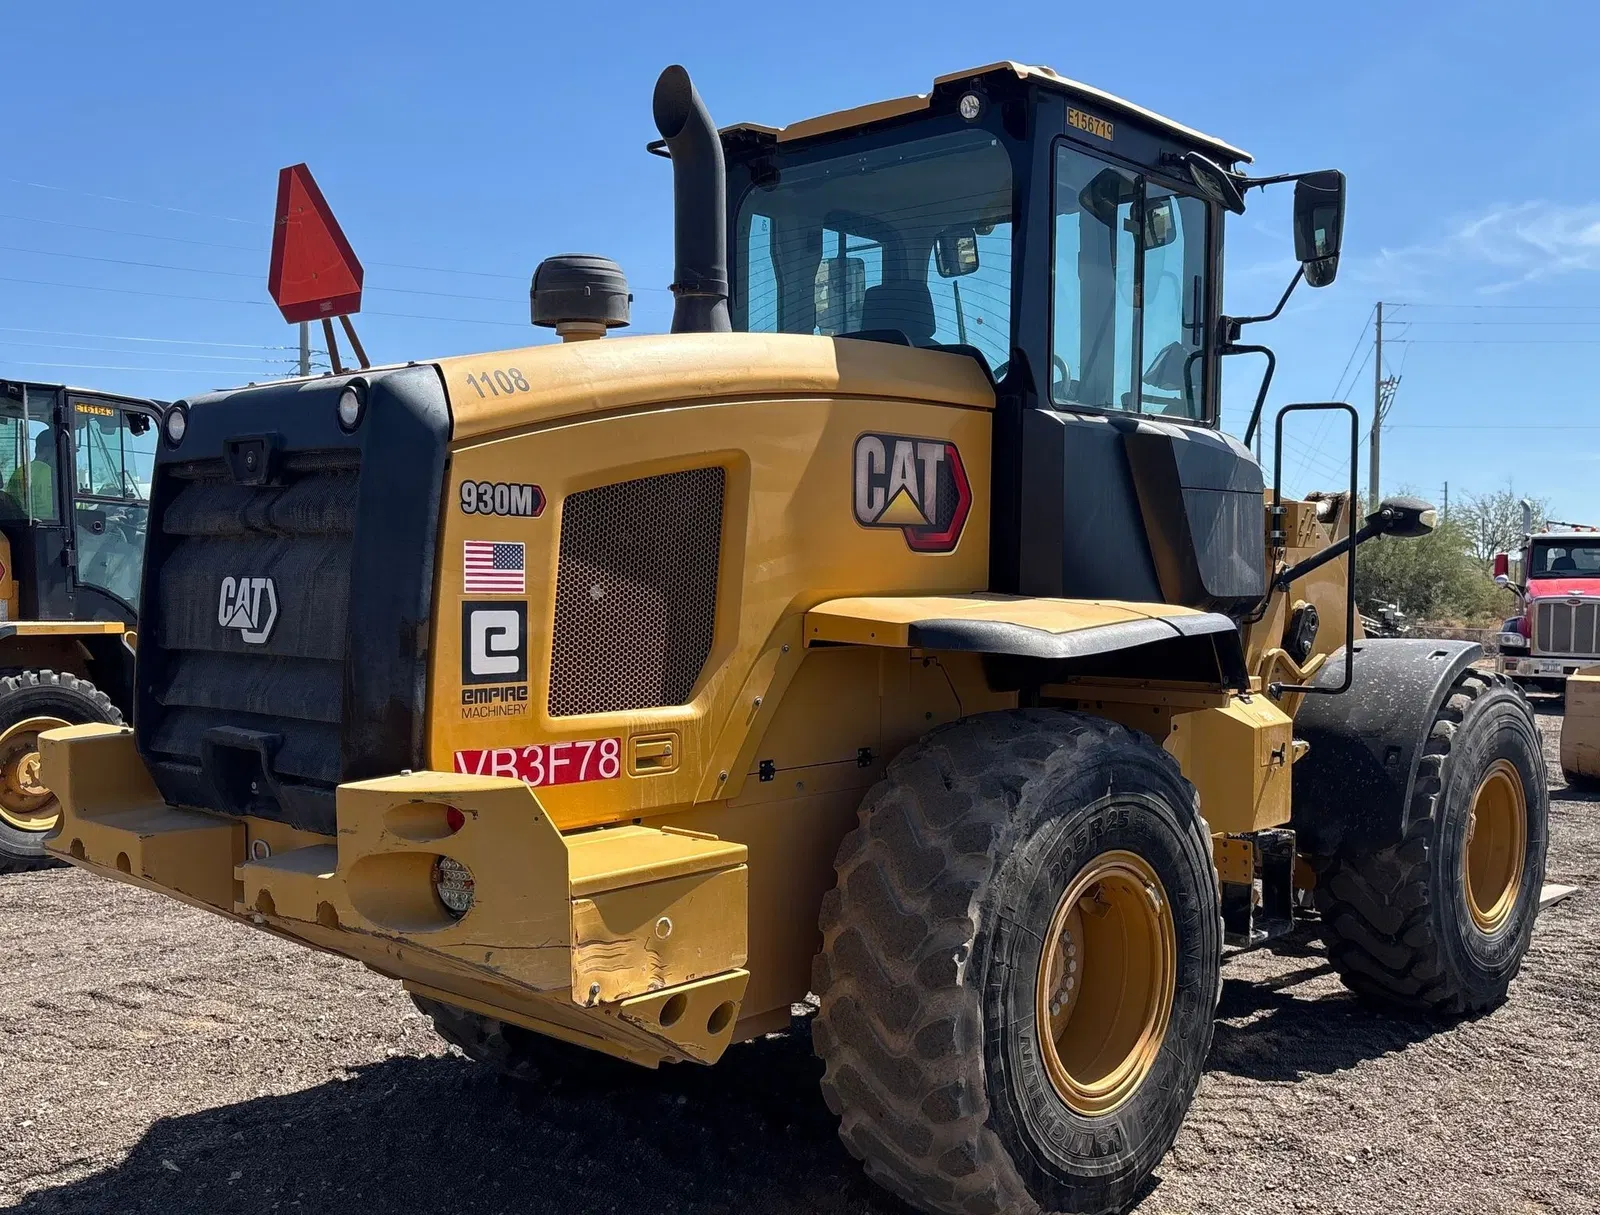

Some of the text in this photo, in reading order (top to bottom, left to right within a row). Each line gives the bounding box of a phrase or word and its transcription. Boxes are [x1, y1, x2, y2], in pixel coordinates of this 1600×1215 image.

[1067, 109, 1113, 140] E156719
[467, 368, 530, 398] 1108
[855, 436, 945, 525] CAT
[461, 480, 532, 516] 930M
[217, 576, 265, 629] CAT
[461, 704, 528, 719] MACHINERY
